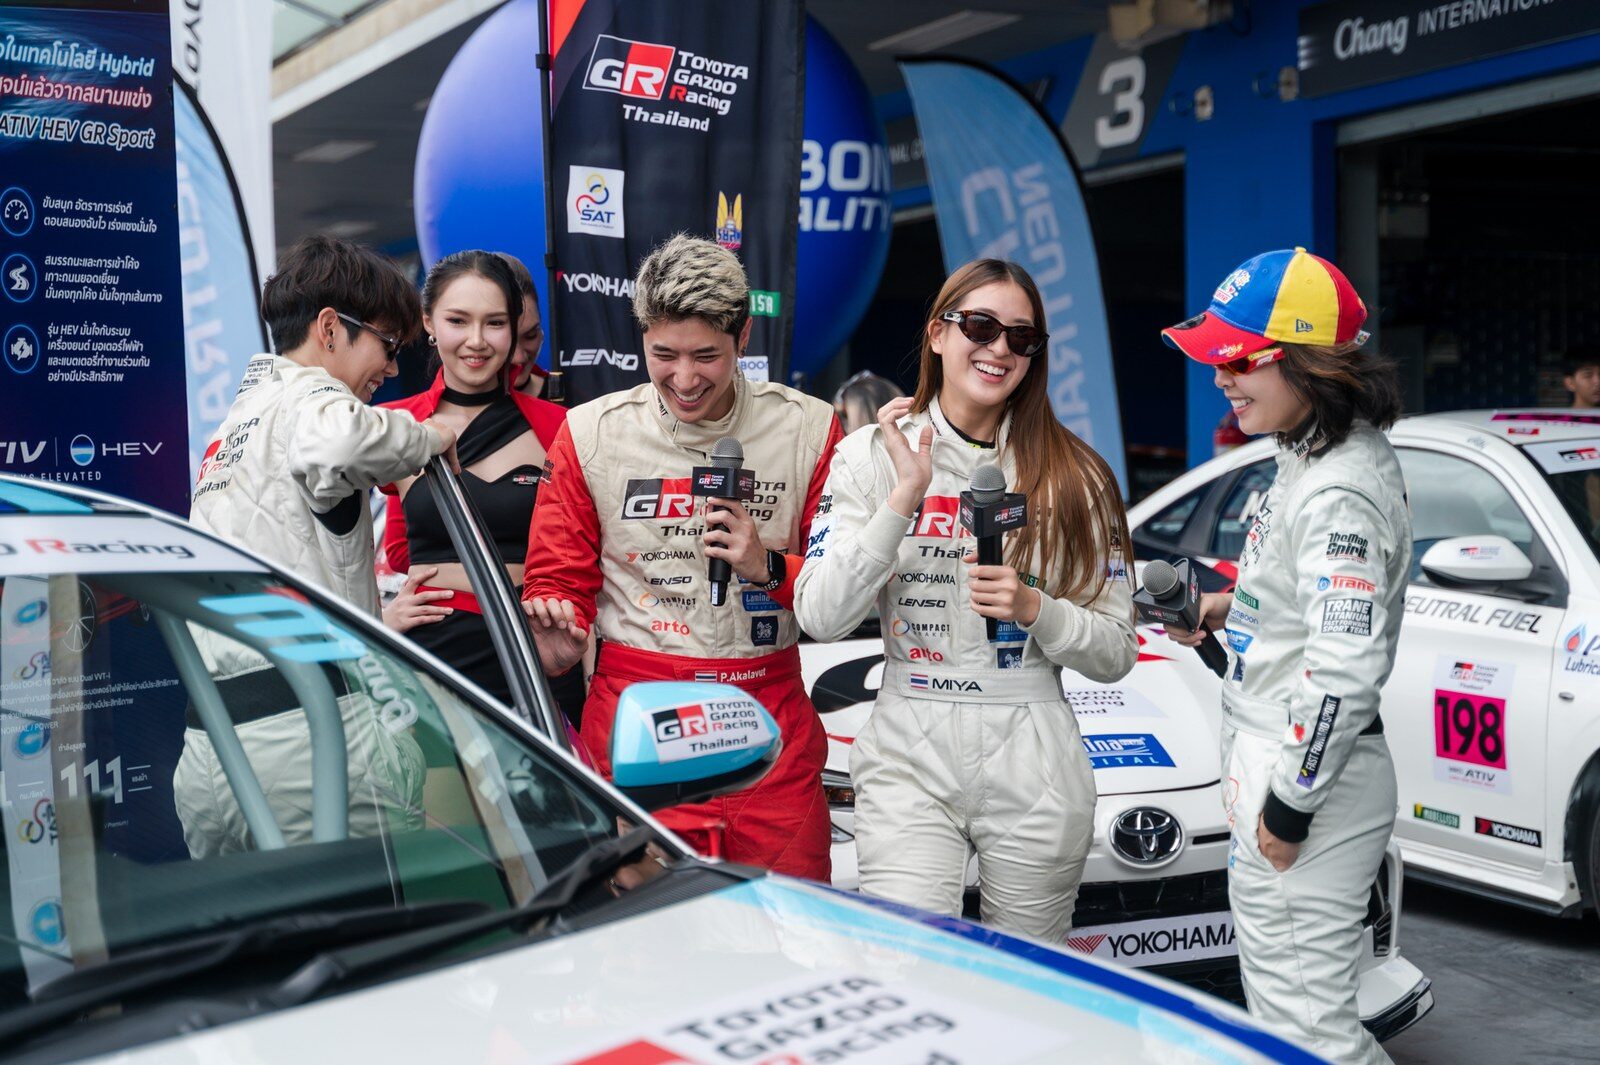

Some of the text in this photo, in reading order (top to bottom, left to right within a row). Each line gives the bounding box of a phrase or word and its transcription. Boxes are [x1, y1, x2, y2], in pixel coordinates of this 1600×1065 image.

[1334, 16, 1409, 60] Chang
[99, 52, 155, 78] Hybrid
[677, 50, 749, 80] TOYOTA
[589, 57, 665, 98] GR
[673, 69, 737, 96] GAZOO
[669, 84, 732, 116] Racing
[1095, 55, 1146, 148] 3
[622, 104, 710, 132] Thailand
[0, 114, 155, 151] ATIV HEV GR Sport
[42, 196, 133, 215] ขับสนุก อัตราการเร่งดี
[43, 215, 157, 233] ตอบสนองฉับไว เร่งแซงมั่นใจ
[581, 209, 616, 223] SAT
[44, 255, 140, 270] สมรรถนะและการเข้าโค้ง
[45, 269, 119, 284] เกาะถนนยอดเยี่ยม
[45, 283, 162, 305] มั่นคงทุกโค้ง มั่นใจทุกเส้นทาง
[47, 321, 131, 338] รุ่น HEV มั่นใจกับระบบ
[47, 335, 143, 352] เครื่องยนต์ มอเตอร์ไฟฟ้า
[47, 352, 150, 367] และแบตเตอรี่ทำงานร่วมกัน
[560, 348, 639, 371] LENSO
[48, 369, 124, 382] อย่างมีประสิทธิภาพ
[102, 442, 163, 456] HEV
[624, 494, 694, 518] GR
[25, 539, 195, 559] Racing
[640, 551, 696, 562] YOKOHAMA
[644, 576, 692, 586] LENSO
[898, 572, 956, 586] YOKOHAMA
[660, 597, 696, 606] COMPACT
[898, 597, 946, 608] LENSO
[1326, 600, 1371, 614] TRANE
[1325, 611, 1370, 622] TITANIUM
[1404, 595, 1542, 634] EUTRAL FUEL
[651, 620, 690, 636] arto
[911, 622, 950, 632] COMPACT
[1323, 625, 1369, 636] SPORT TEAM
[909, 647, 943, 662] arto
[720, 668, 766, 683] P.Akalavut
[932, 678, 982, 692] MIYA
[706, 701, 755, 712] TOYOTA
[710, 711, 756, 721] GAZOO
[656, 715, 707, 742] GR
[712, 719, 758, 732] Racing
[1437, 696, 1502, 763] 198
[1306, 699, 1337, 771] FAST FORWARD SPORT
[689, 736, 747, 753] Thailand
[1466, 769, 1495, 781] ATIV
[1491, 822, 1539, 846] YOKOHAMA
[1107, 923, 1237, 958] YOKOHAMA
[664, 973, 886, 1041] TOYOTA
[713, 992, 908, 1063] GAZOO
